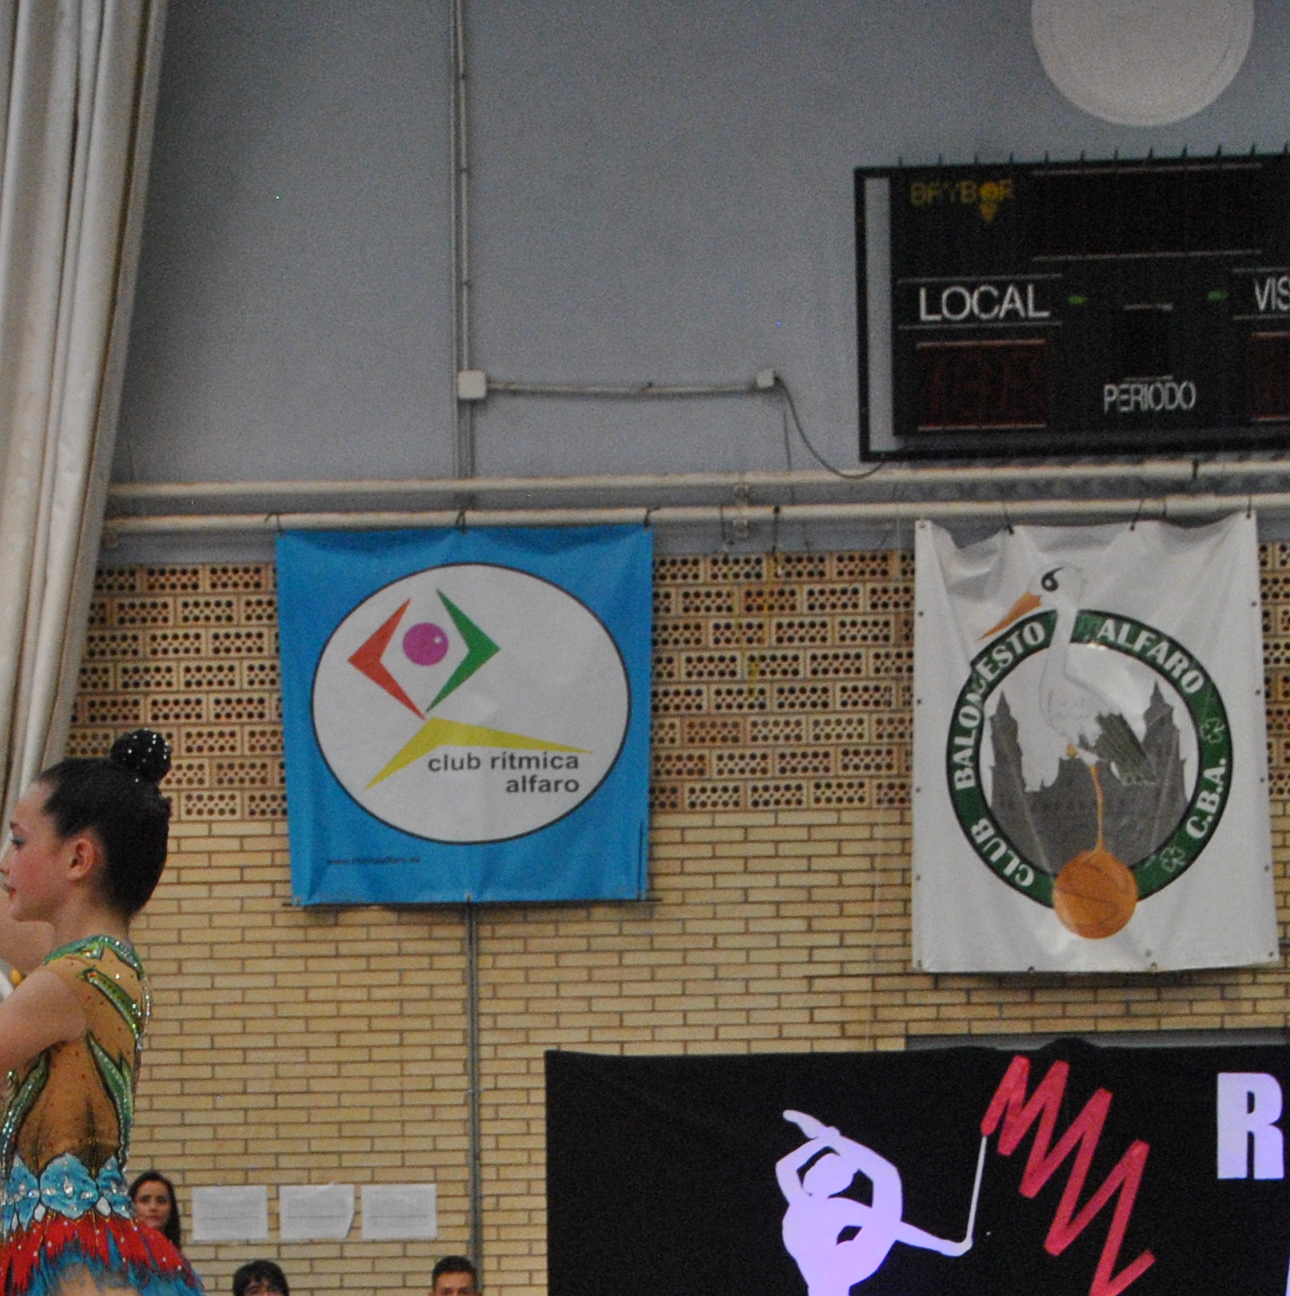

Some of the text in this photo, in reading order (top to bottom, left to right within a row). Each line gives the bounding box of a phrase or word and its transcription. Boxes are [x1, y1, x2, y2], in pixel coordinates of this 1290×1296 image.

[919, 284, 1050, 321] LOCAL
[1104, 381, 1196, 413] PERIODO
[1098, 618, 1204, 694] ALFARO
[427, 751, 580, 772] club rítmica
[505, 774, 580, 794] alfaro
[970, 817, 1035, 888] CLUB
